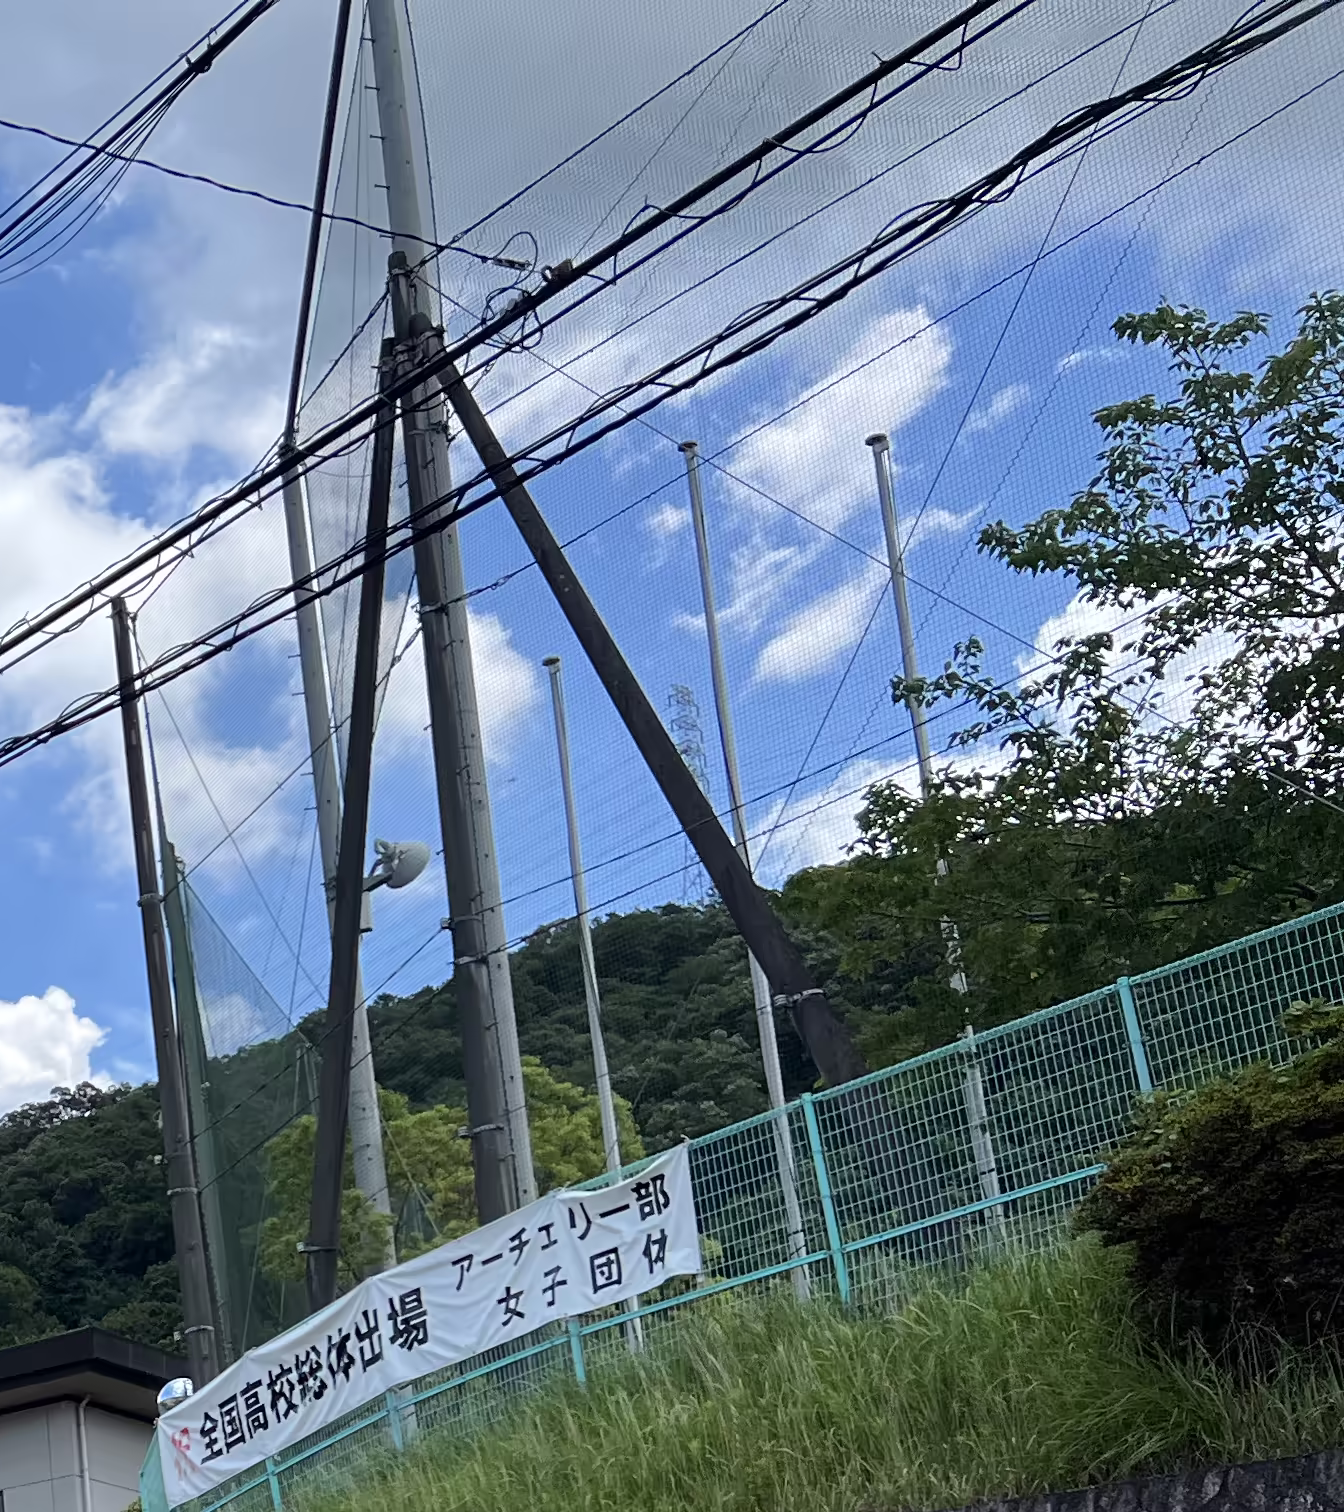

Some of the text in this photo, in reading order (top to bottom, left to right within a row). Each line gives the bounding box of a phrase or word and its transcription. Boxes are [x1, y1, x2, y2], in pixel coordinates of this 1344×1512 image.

[450, 1172, 671, 1293] アーチェリー部
[496, 1229, 669, 1329] 女子団体
[198, 1287, 430, 1466] 全国高校総体出場
